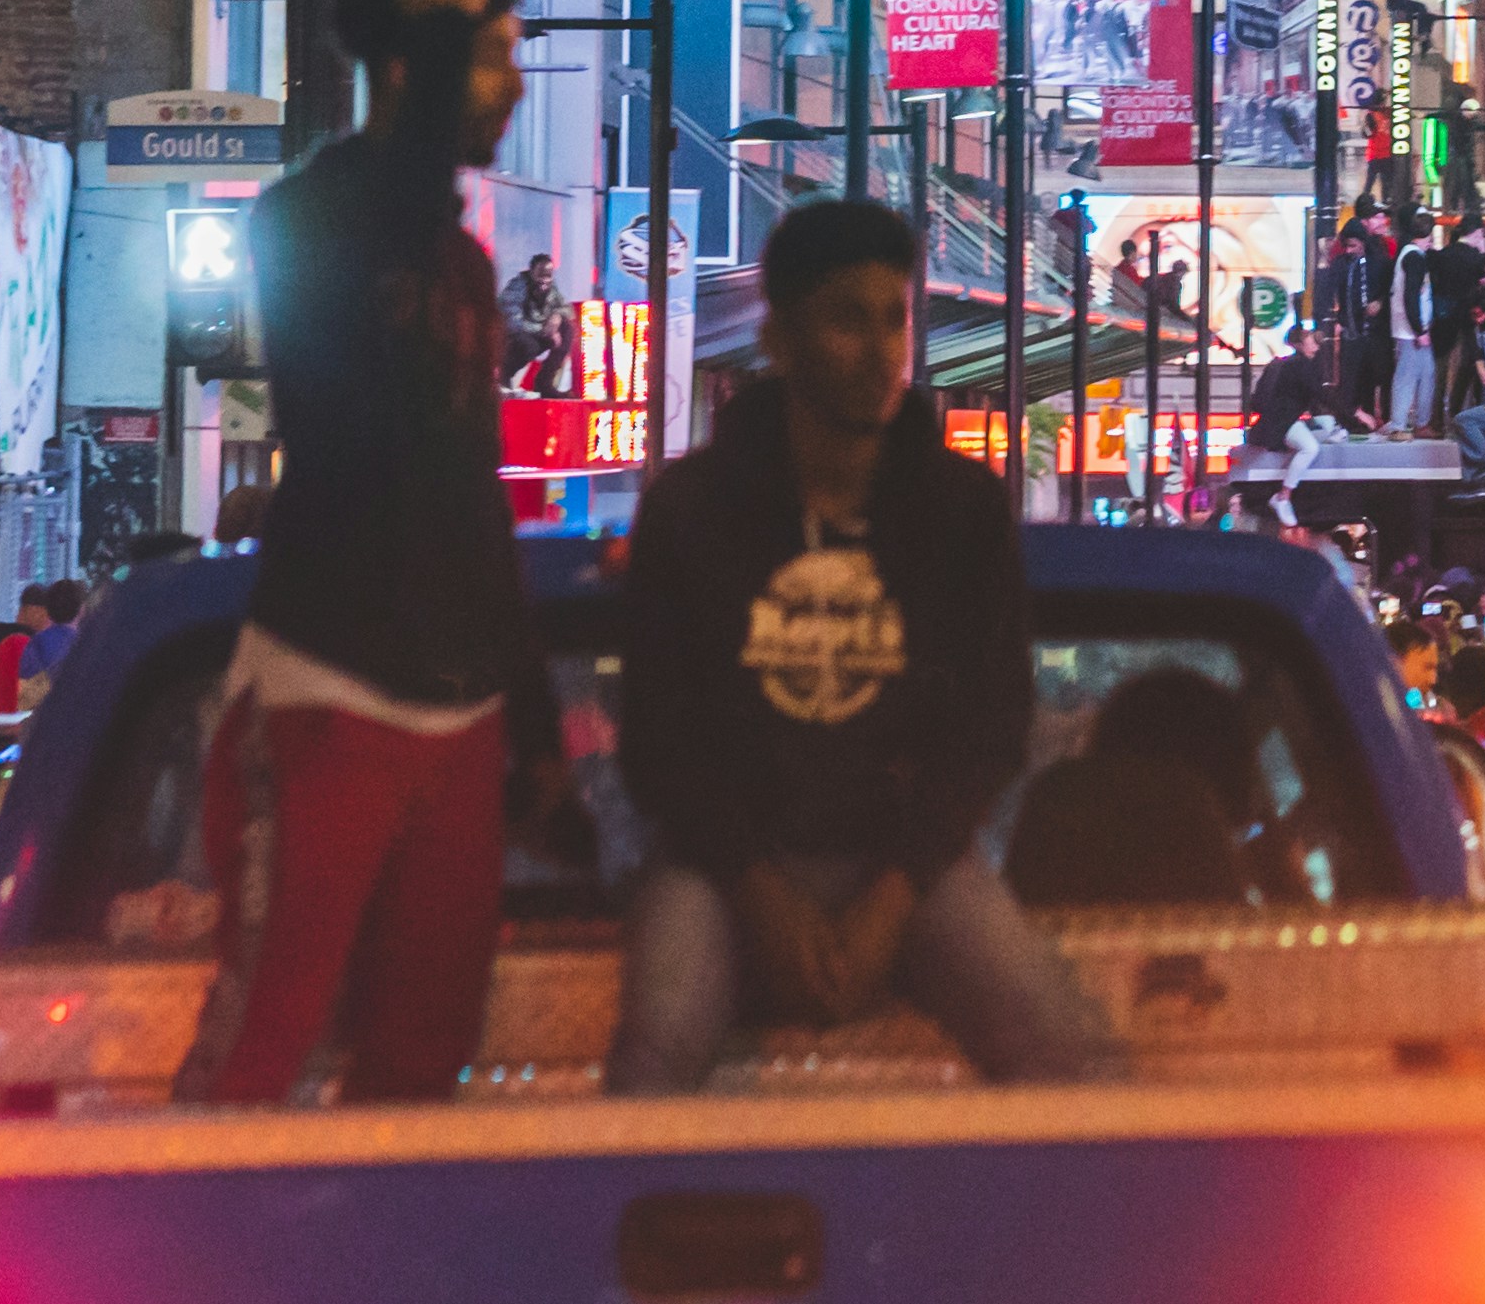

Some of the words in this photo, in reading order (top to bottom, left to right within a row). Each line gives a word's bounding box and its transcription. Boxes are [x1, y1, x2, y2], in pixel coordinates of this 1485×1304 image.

[903, 14, 1001, 32] CULTURAL
[892, 33, 958, 52] HEART
[1392, 22, 1411, 156] DOWNTOWN
[1112, 110, 1194, 124] CULTURAL
[1102, 125, 1158, 139] HEART
[141, 132, 219, 159] Gould
[225, 137, 246, 159] St
